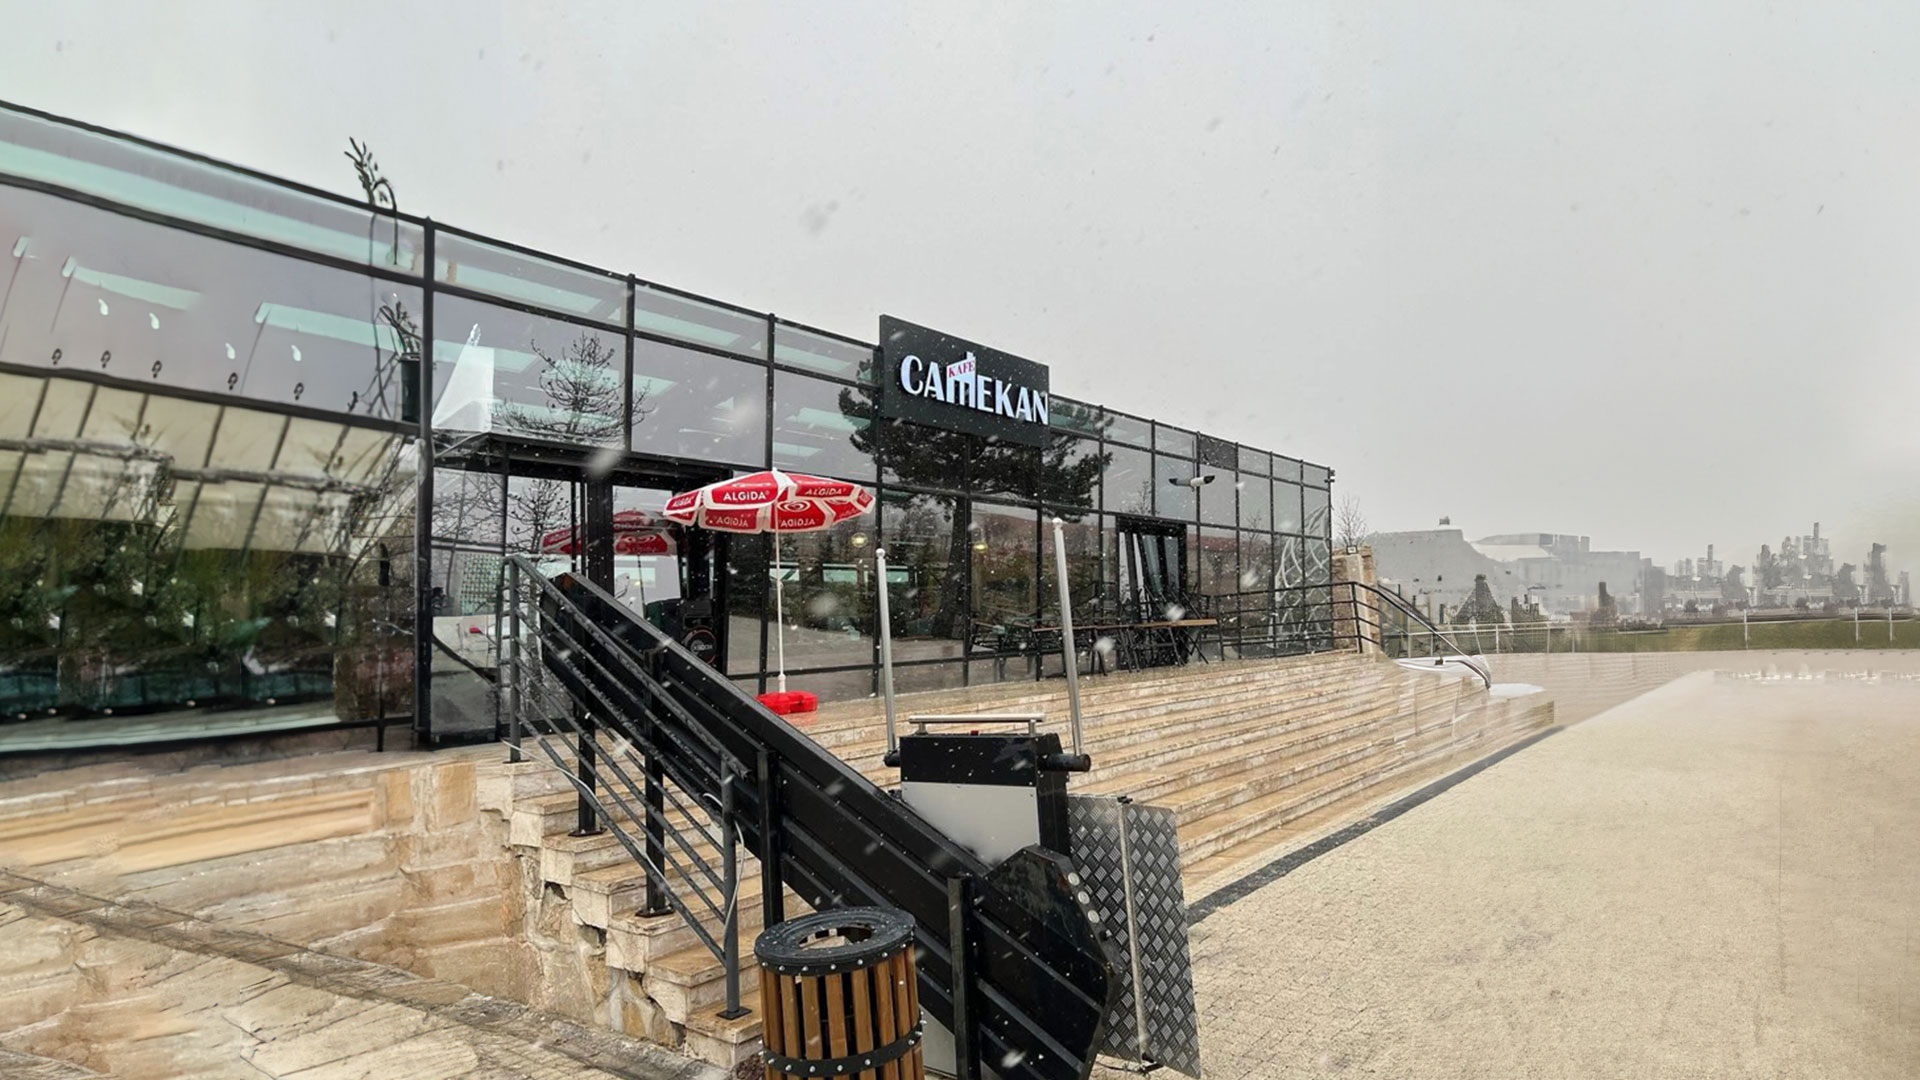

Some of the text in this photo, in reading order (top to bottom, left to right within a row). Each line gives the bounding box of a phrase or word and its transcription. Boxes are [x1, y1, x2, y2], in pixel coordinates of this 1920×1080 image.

[949, 361, 975, 378] KAFE
[901, 351, 1048, 425] CAMEKAN
[723, 491, 767, 501] ALGIDA
[804, 487, 842, 496] ALGIDA
